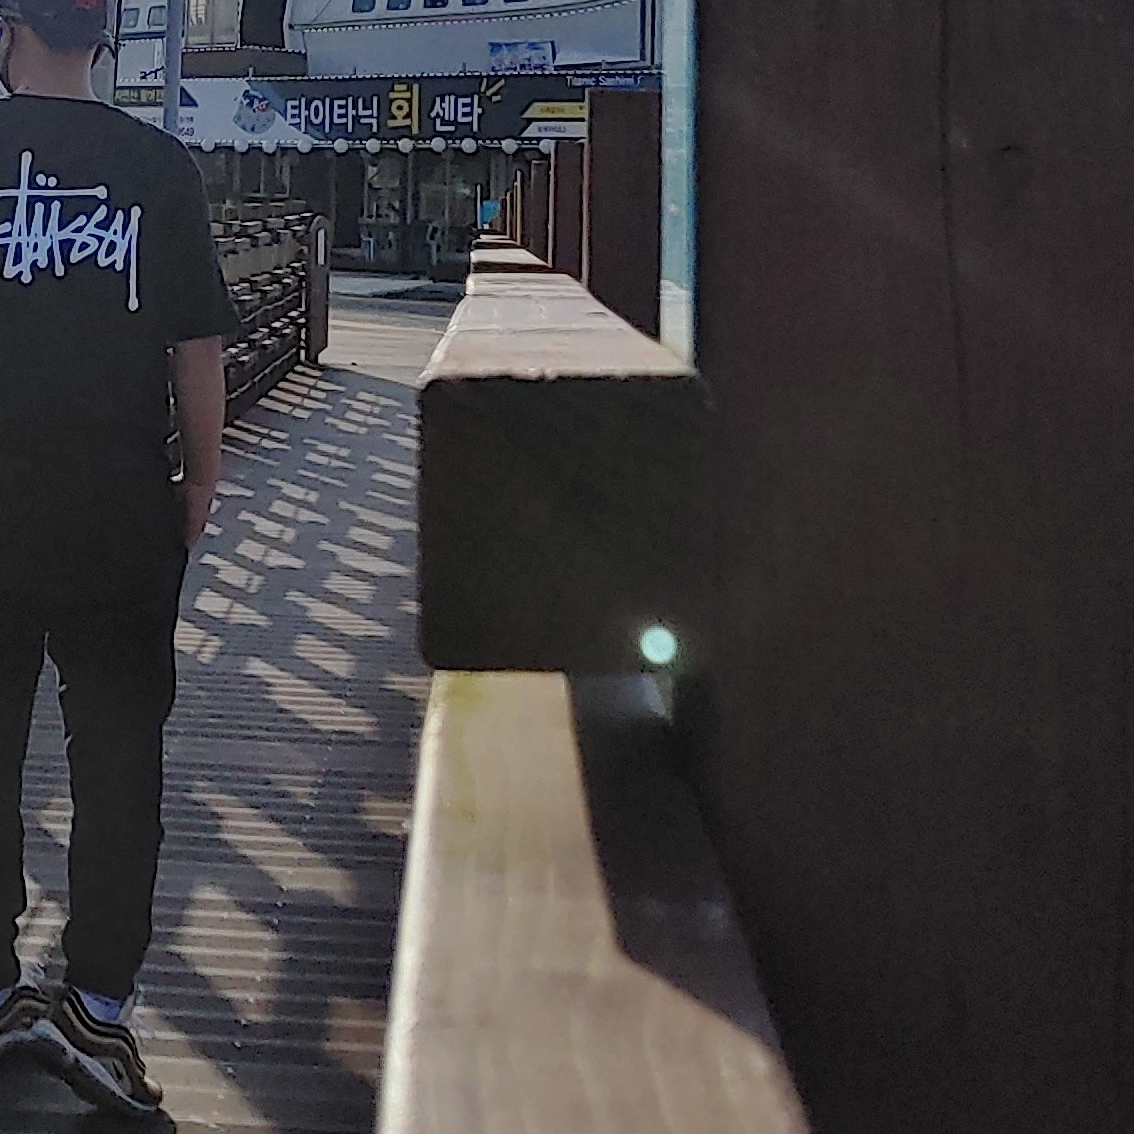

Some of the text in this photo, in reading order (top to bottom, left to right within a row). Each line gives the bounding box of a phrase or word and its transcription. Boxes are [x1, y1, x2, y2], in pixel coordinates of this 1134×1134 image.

[285, 82, 483, 135] 타이타닉 회 센타
